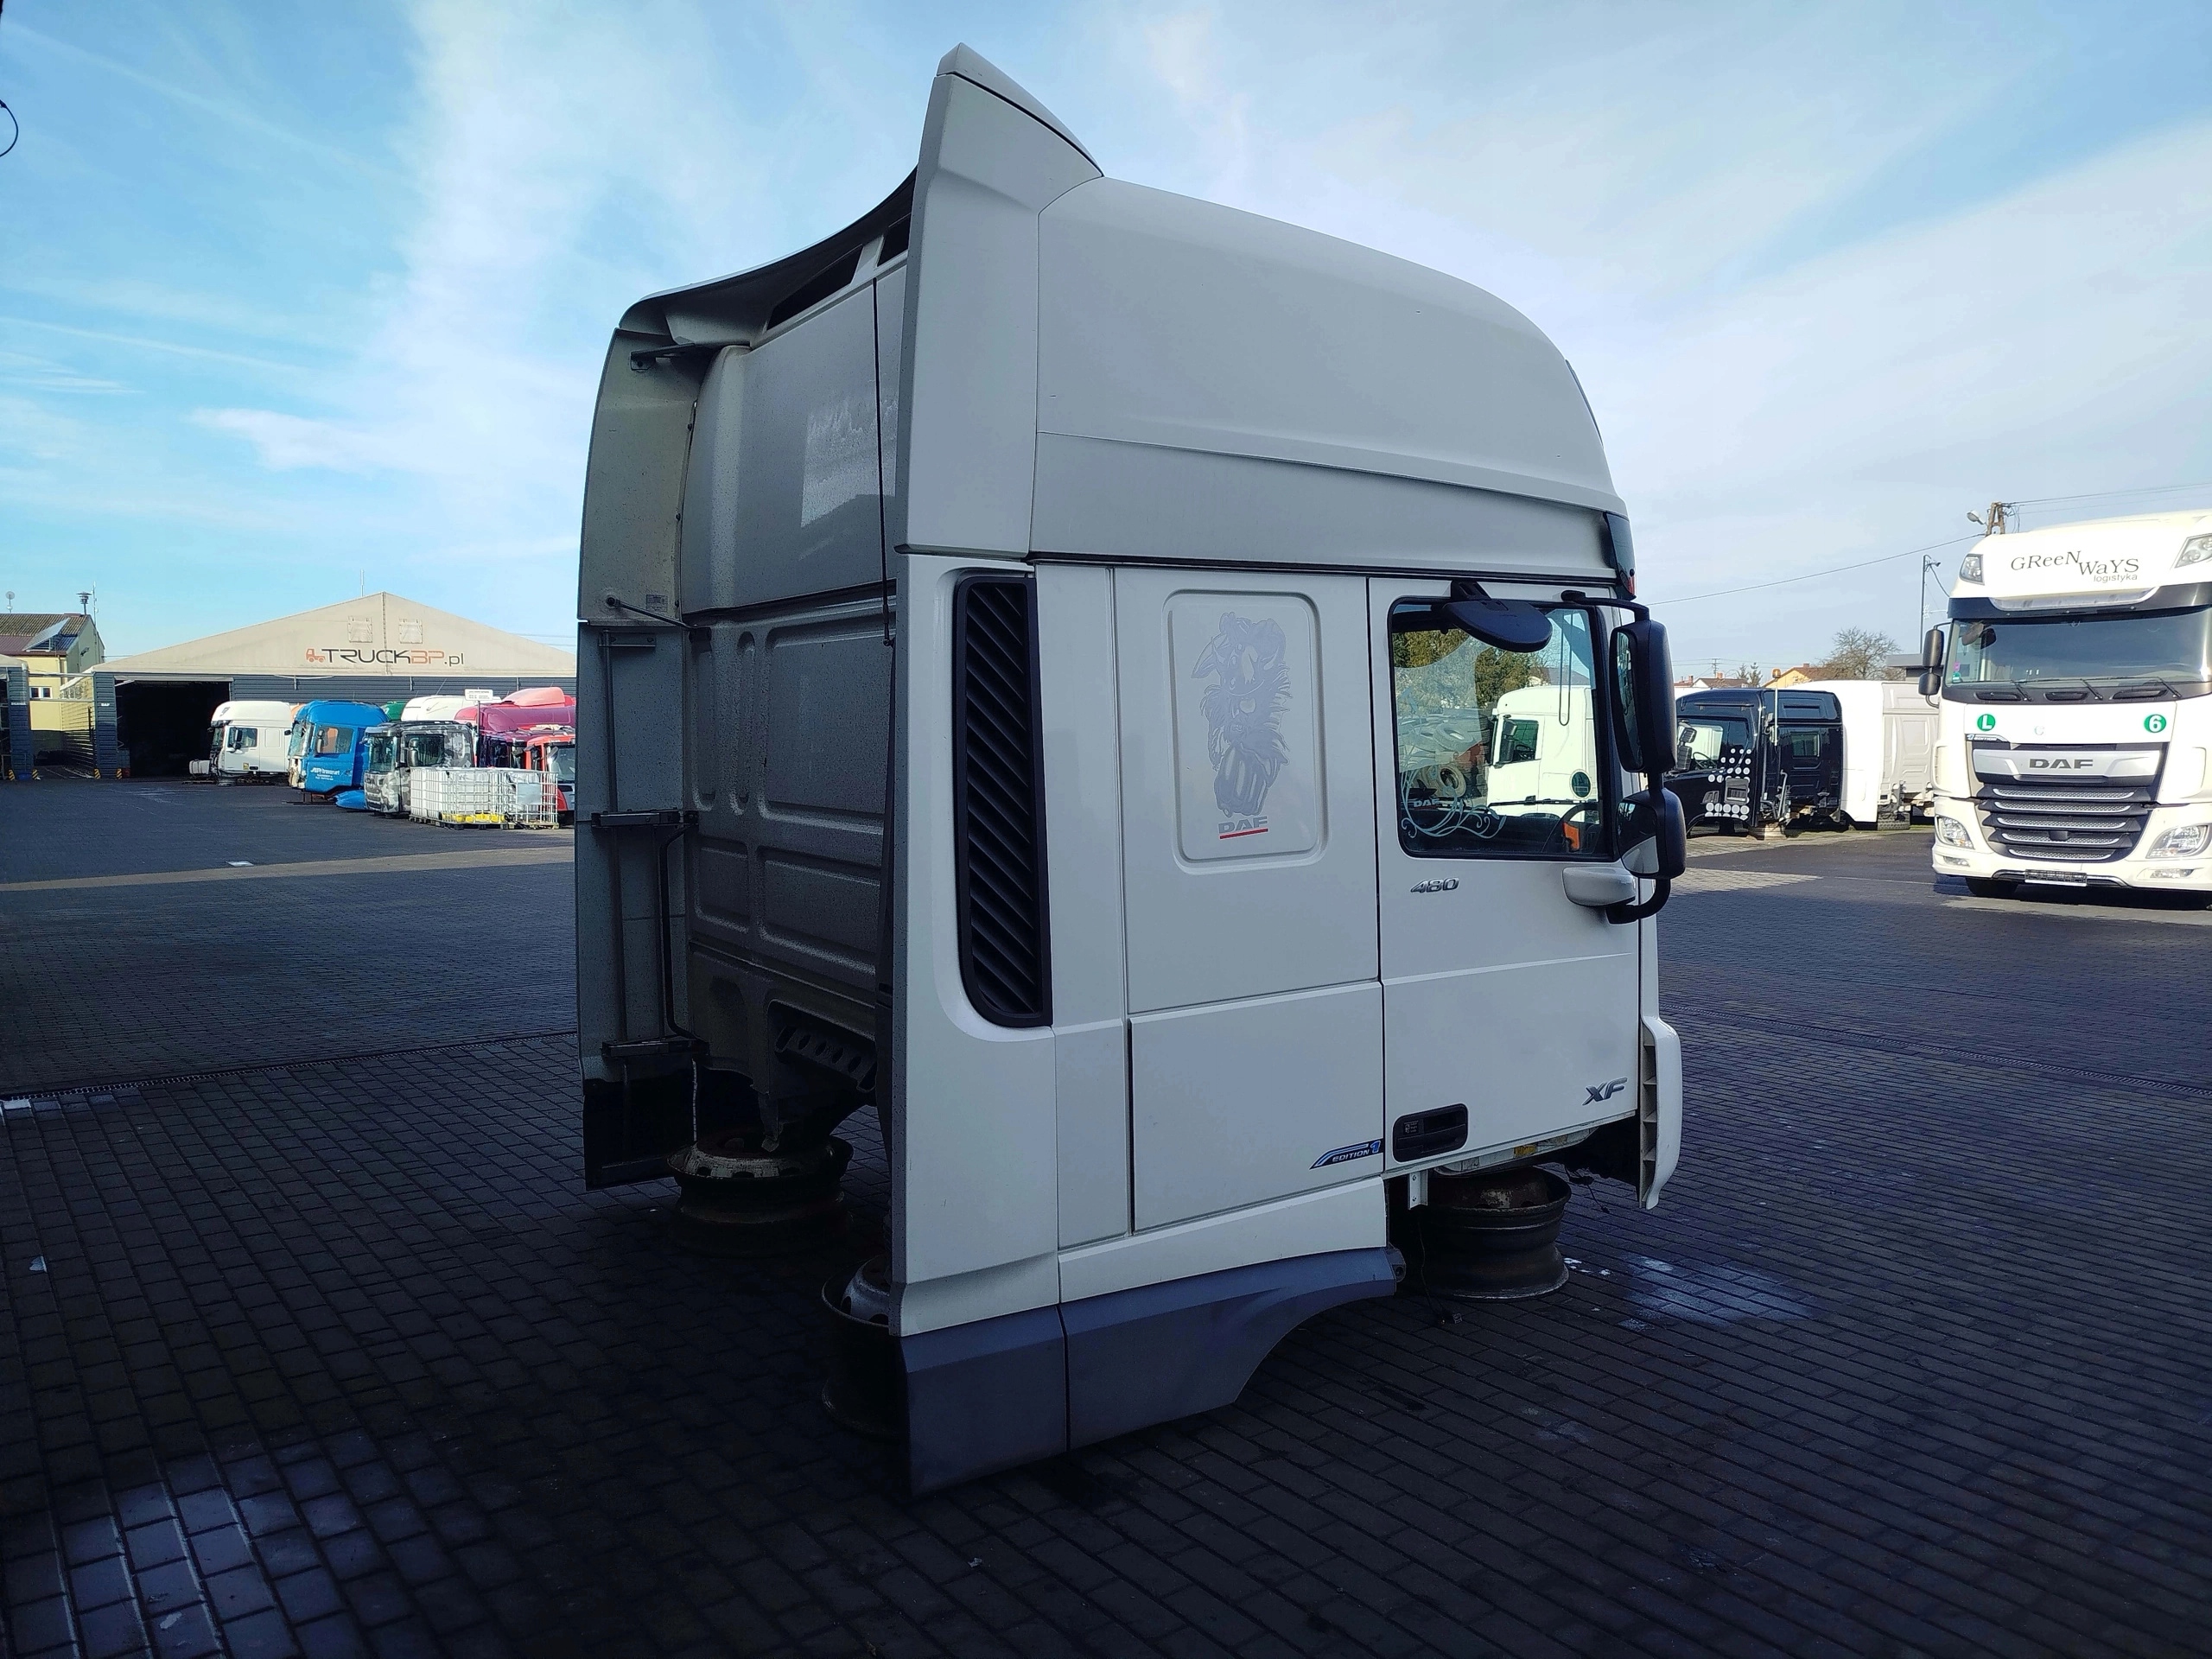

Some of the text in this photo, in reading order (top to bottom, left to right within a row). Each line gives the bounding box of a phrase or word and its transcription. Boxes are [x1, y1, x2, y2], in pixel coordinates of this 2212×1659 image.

[2094, 574, 2138, 583] logistyka
[321, 648, 464, 666] TRUCKBP.pl
[1982, 715, 1993, 730] L
[2149, 715, 2162, 732] 6
[2029, 759, 2094, 769] DAF
[1413, 798, 1440, 807] DAF
[1217, 816, 1268, 834] DAF
[1409, 877, 1460, 893] 480
[1581, 1077, 1628, 1106] XF
[1332, 1140, 1381, 1162] EDITION 1
